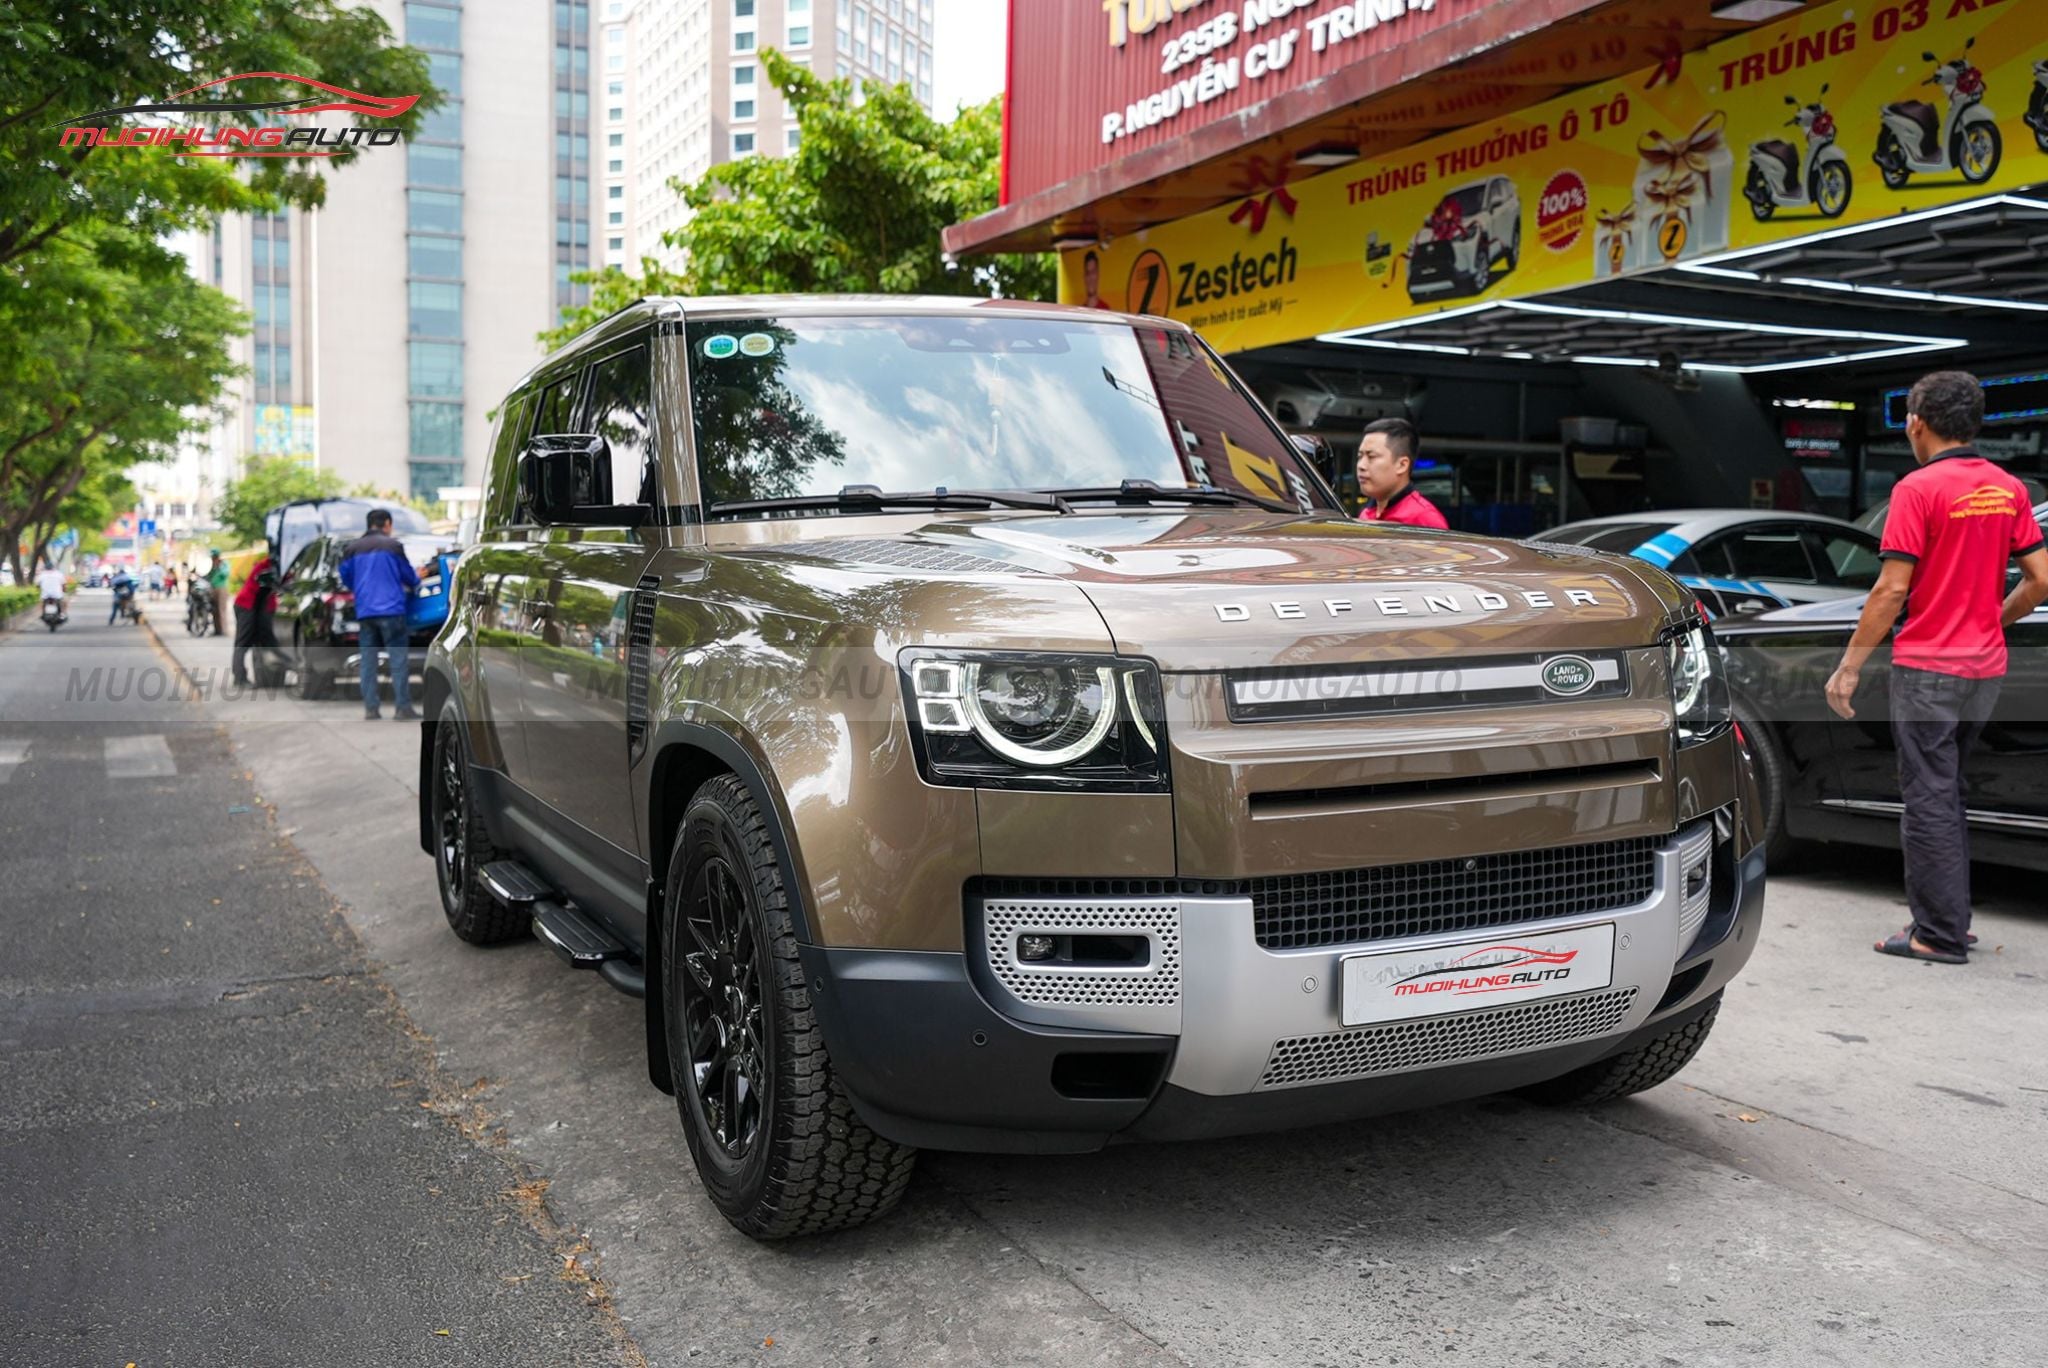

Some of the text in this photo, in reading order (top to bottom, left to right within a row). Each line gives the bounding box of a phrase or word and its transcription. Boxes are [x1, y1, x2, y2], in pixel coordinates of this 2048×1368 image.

[1161, 11, 1239, 74] 235B
[1244, 28, 1300, 79] CƯ
[1718, 21, 1857, 92] TRÚNG
[1872, 0, 1929, 42] 03
[1346, 161, 1427, 205] TRÚNG
[1559, 109, 1580, 142] Ô
[1591, 93, 1630, 132] TÔ
[1541, 187, 1585, 217] 100%
[1175, 236, 1298, 309] Zestech
[1213, 588, 1600, 622] DEFENDER
[1553, 665, 1576, 676] LAND
[1557, 673, 1585, 685] ROVER
